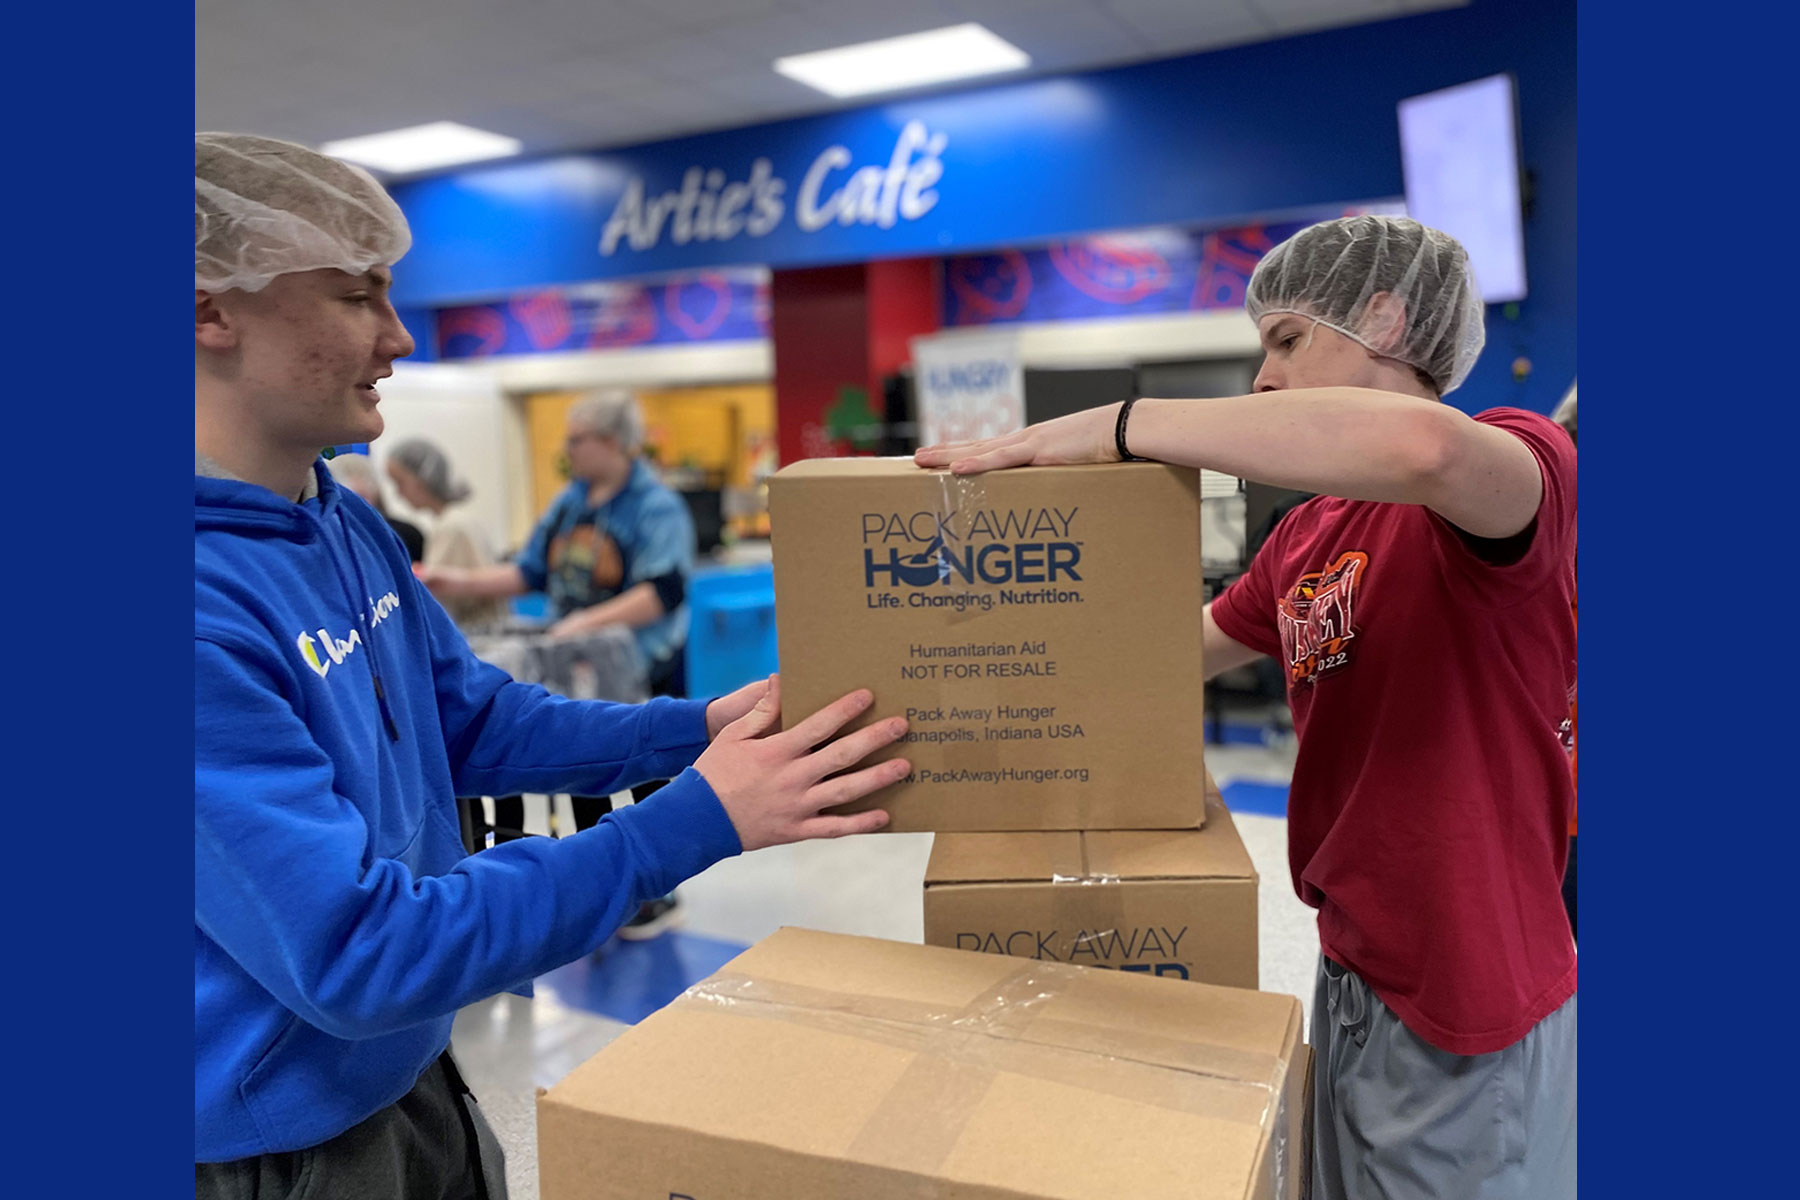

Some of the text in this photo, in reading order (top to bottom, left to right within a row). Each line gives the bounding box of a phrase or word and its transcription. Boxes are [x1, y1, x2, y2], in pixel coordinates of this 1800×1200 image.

[598, 119, 948, 256] Artie's Café
[862, 507, 1078, 543] PACK AWAY
[867, 589, 1084, 612] Life. Changing. Nutrition.
[297, 591, 400, 678] Chaion
[910, 641, 1046, 658] Humanitarian Aid
[901, 661, 1056, 679] NOT FOR RESALE
[906, 705, 1056, 723] Pack Away Hunger
[897, 724, 1085, 744] ianapolis, Indiana USA
[898, 768, 1089, 785] w.PackAwayHunger.org
[956, 926, 1188, 961] PACK AWAY
